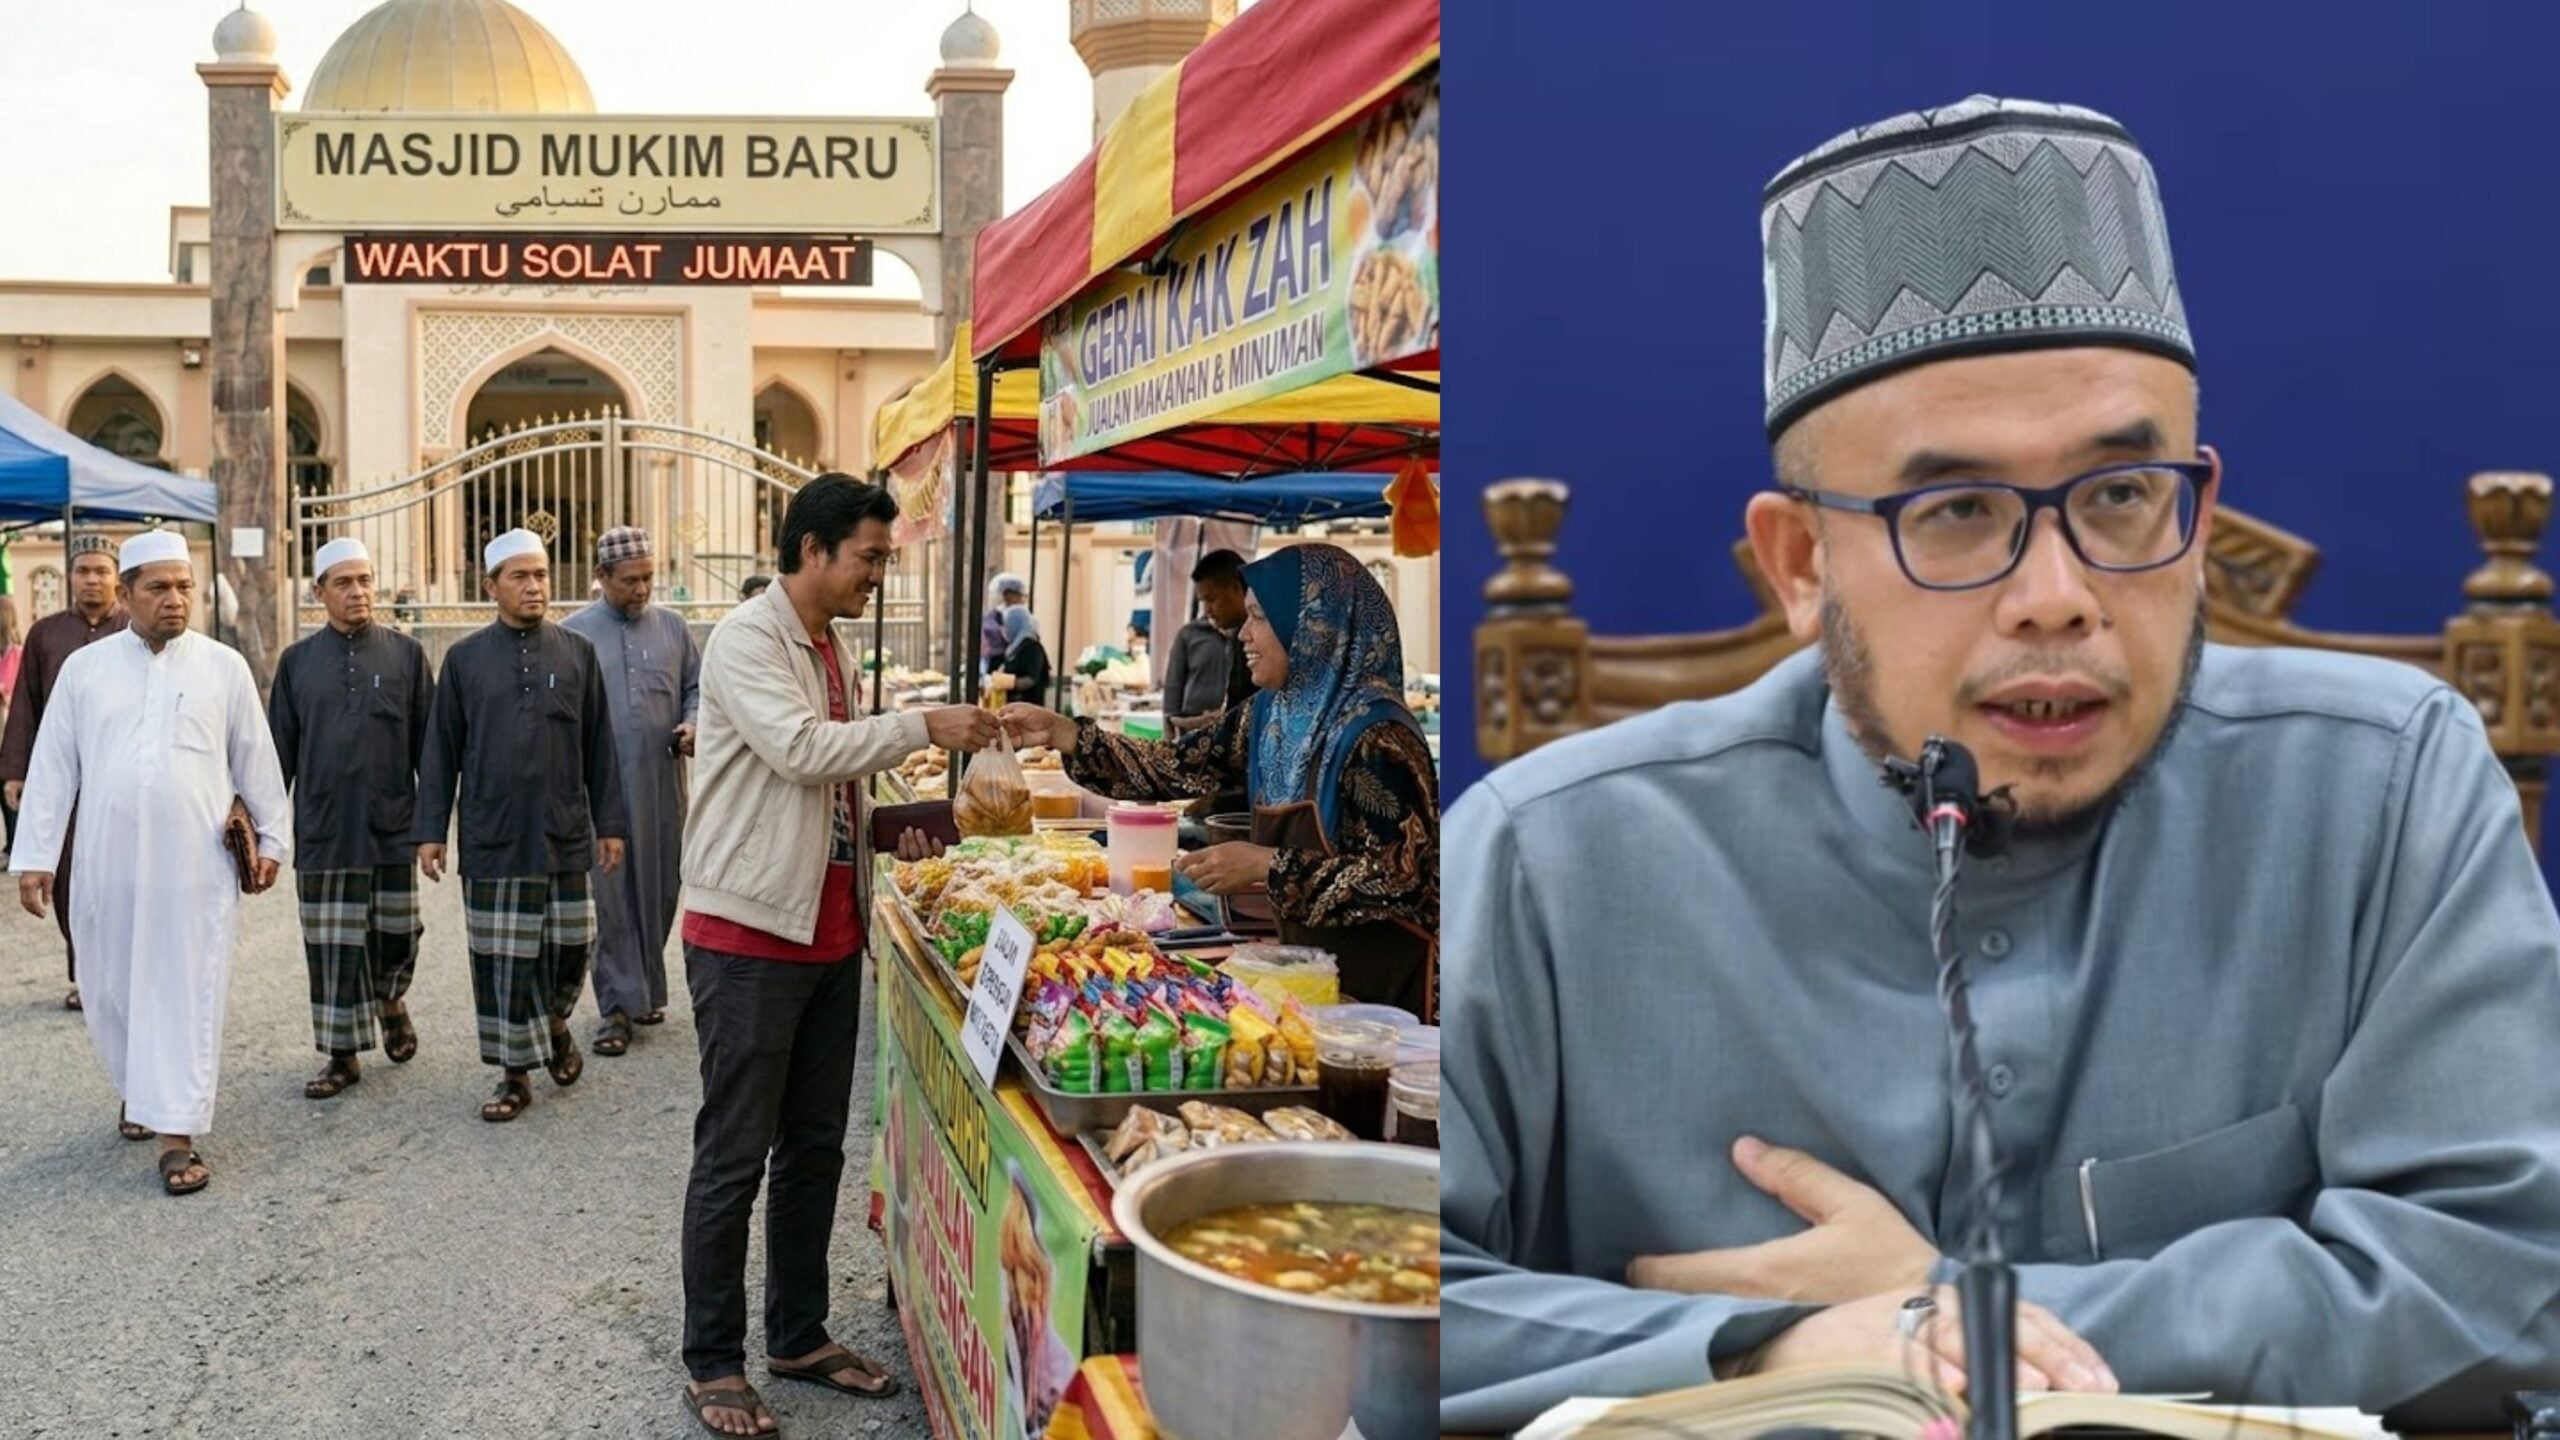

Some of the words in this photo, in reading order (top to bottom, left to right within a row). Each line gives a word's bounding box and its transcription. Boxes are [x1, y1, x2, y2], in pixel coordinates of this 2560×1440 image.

[315, 132, 520, 177] MASJID
[541, 133, 724, 178] MUKIM
[746, 135, 898, 179] BARU
[355, 243, 509, 277] WAKTU
[522, 243, 661, 278] SOLAT
[683, 245, 855, 280] JUMAAT
[1080, 277, 1160, 386] GERAI
[1166, 233, 1239, 354] KAK
[1243, 175, 1333, 319] ZAH
[1086, 387, 1131, 438] JUALAN
[1133, 360, 1209, 420] MAKANAN
[1212, 353, 1225, 395] &
[1229, 313, 1324, 390] MINUMAN
